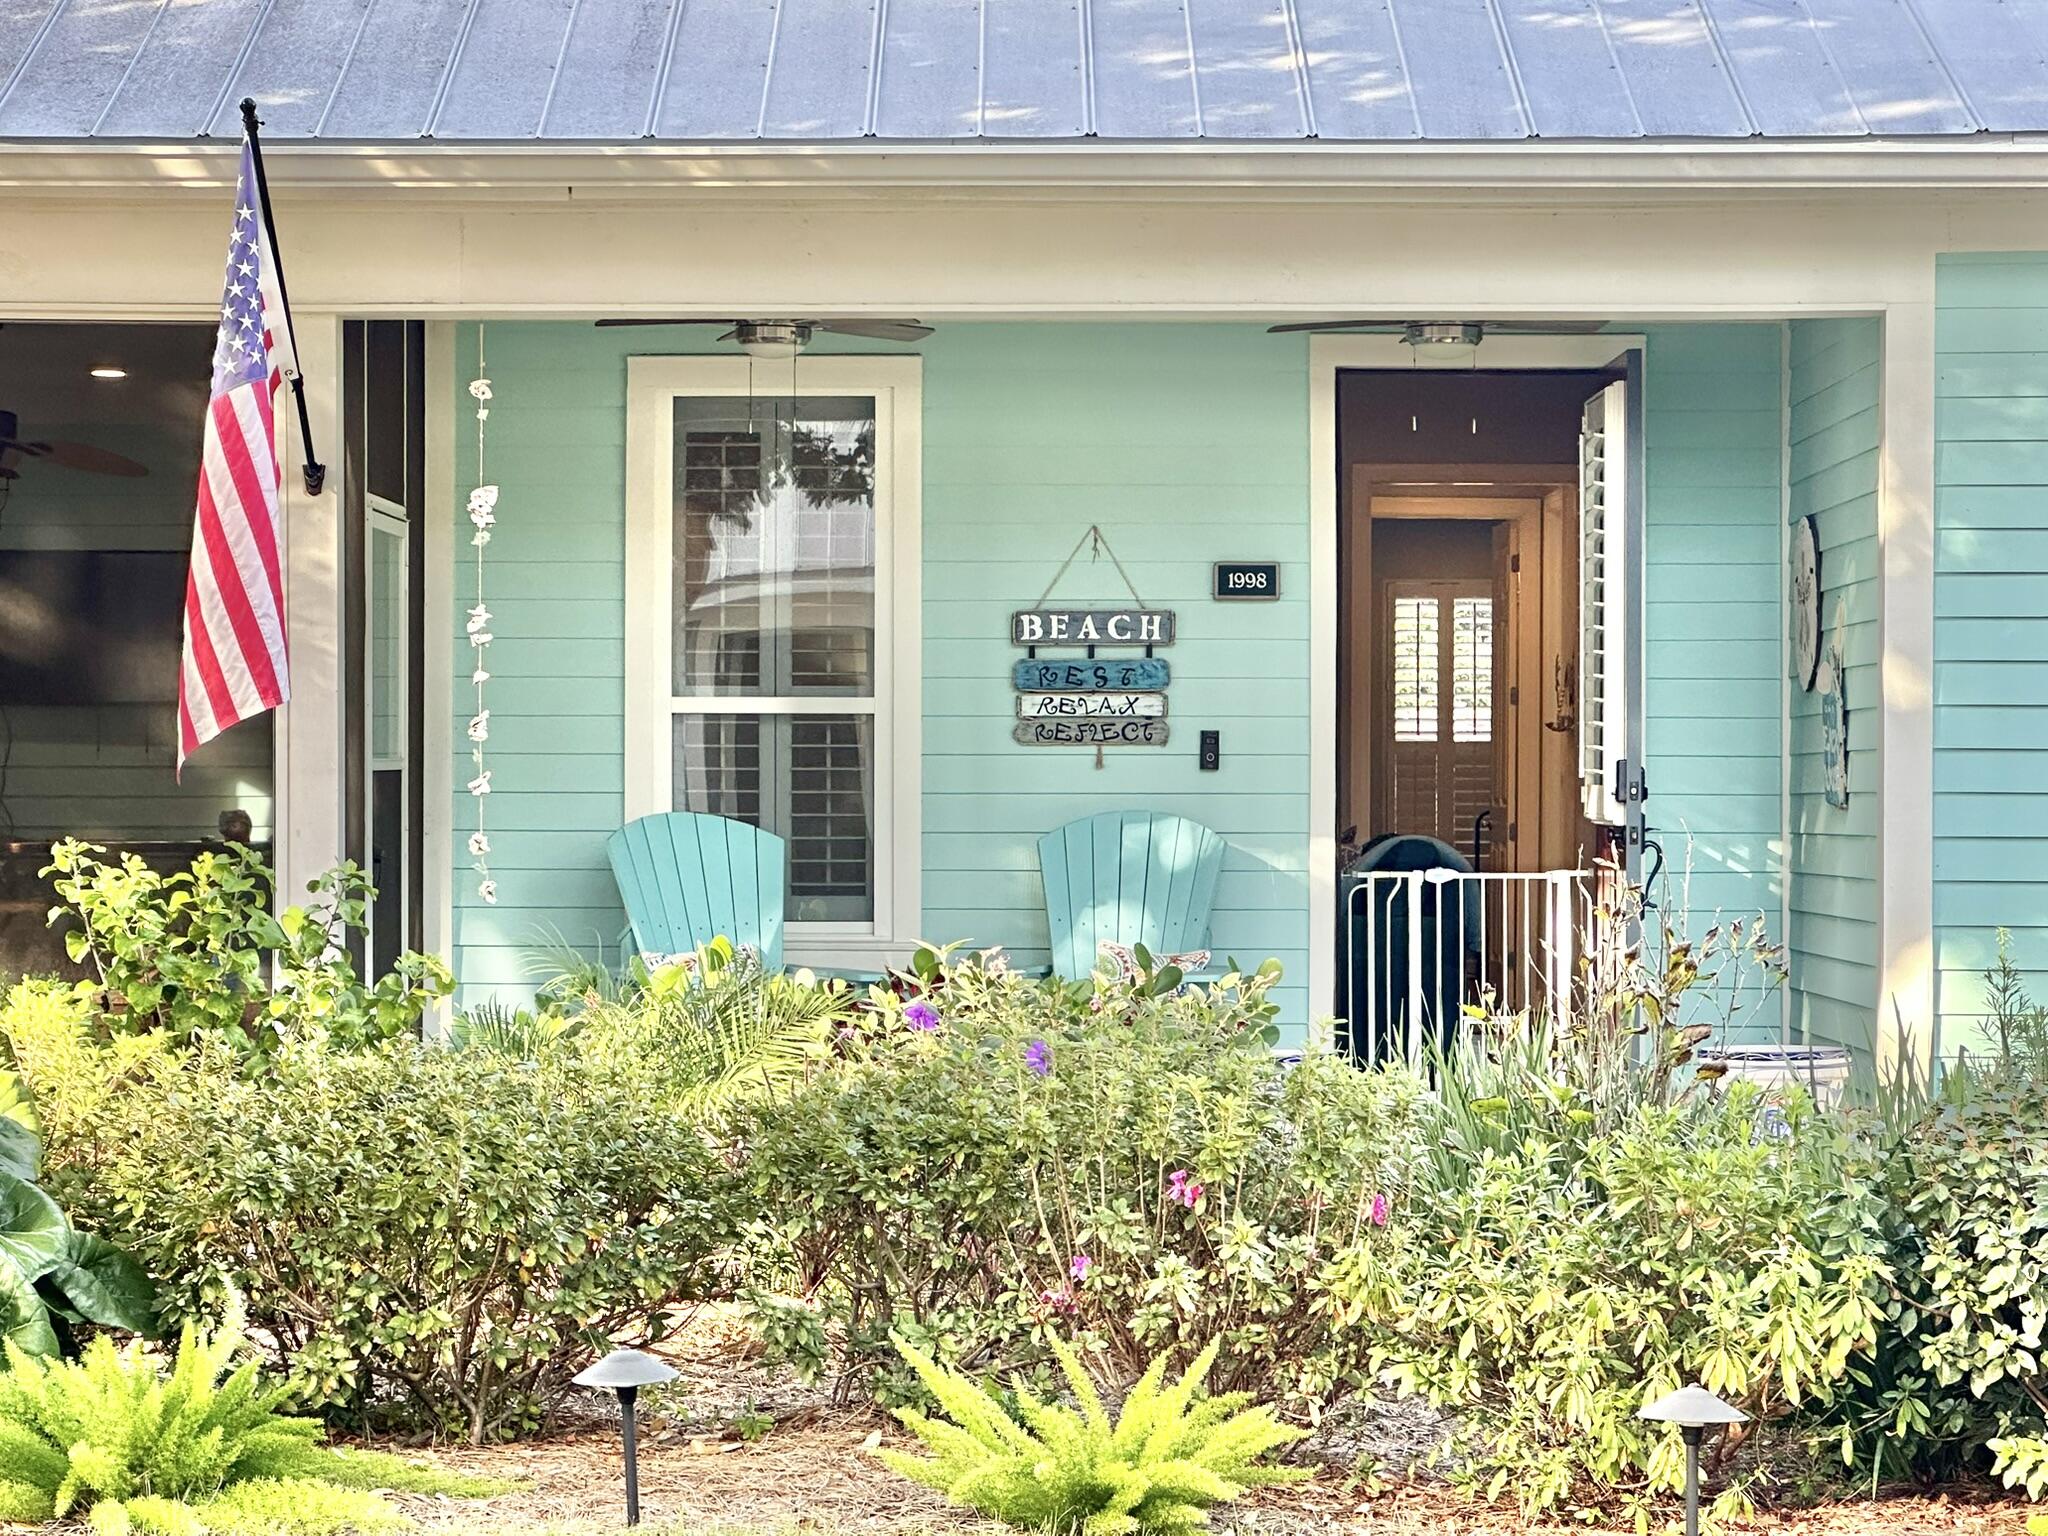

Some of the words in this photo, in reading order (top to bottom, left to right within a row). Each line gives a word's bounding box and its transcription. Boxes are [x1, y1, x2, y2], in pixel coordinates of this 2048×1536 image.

[1227, 573, 1267, 588] 1998
[1020, 615, 1161, 640] BEACH
[1039, 666, 1136, 687] REST
[1037, 696, 1139, 714] RELAX
[1034, 723, 1154, 741] REFLECT
